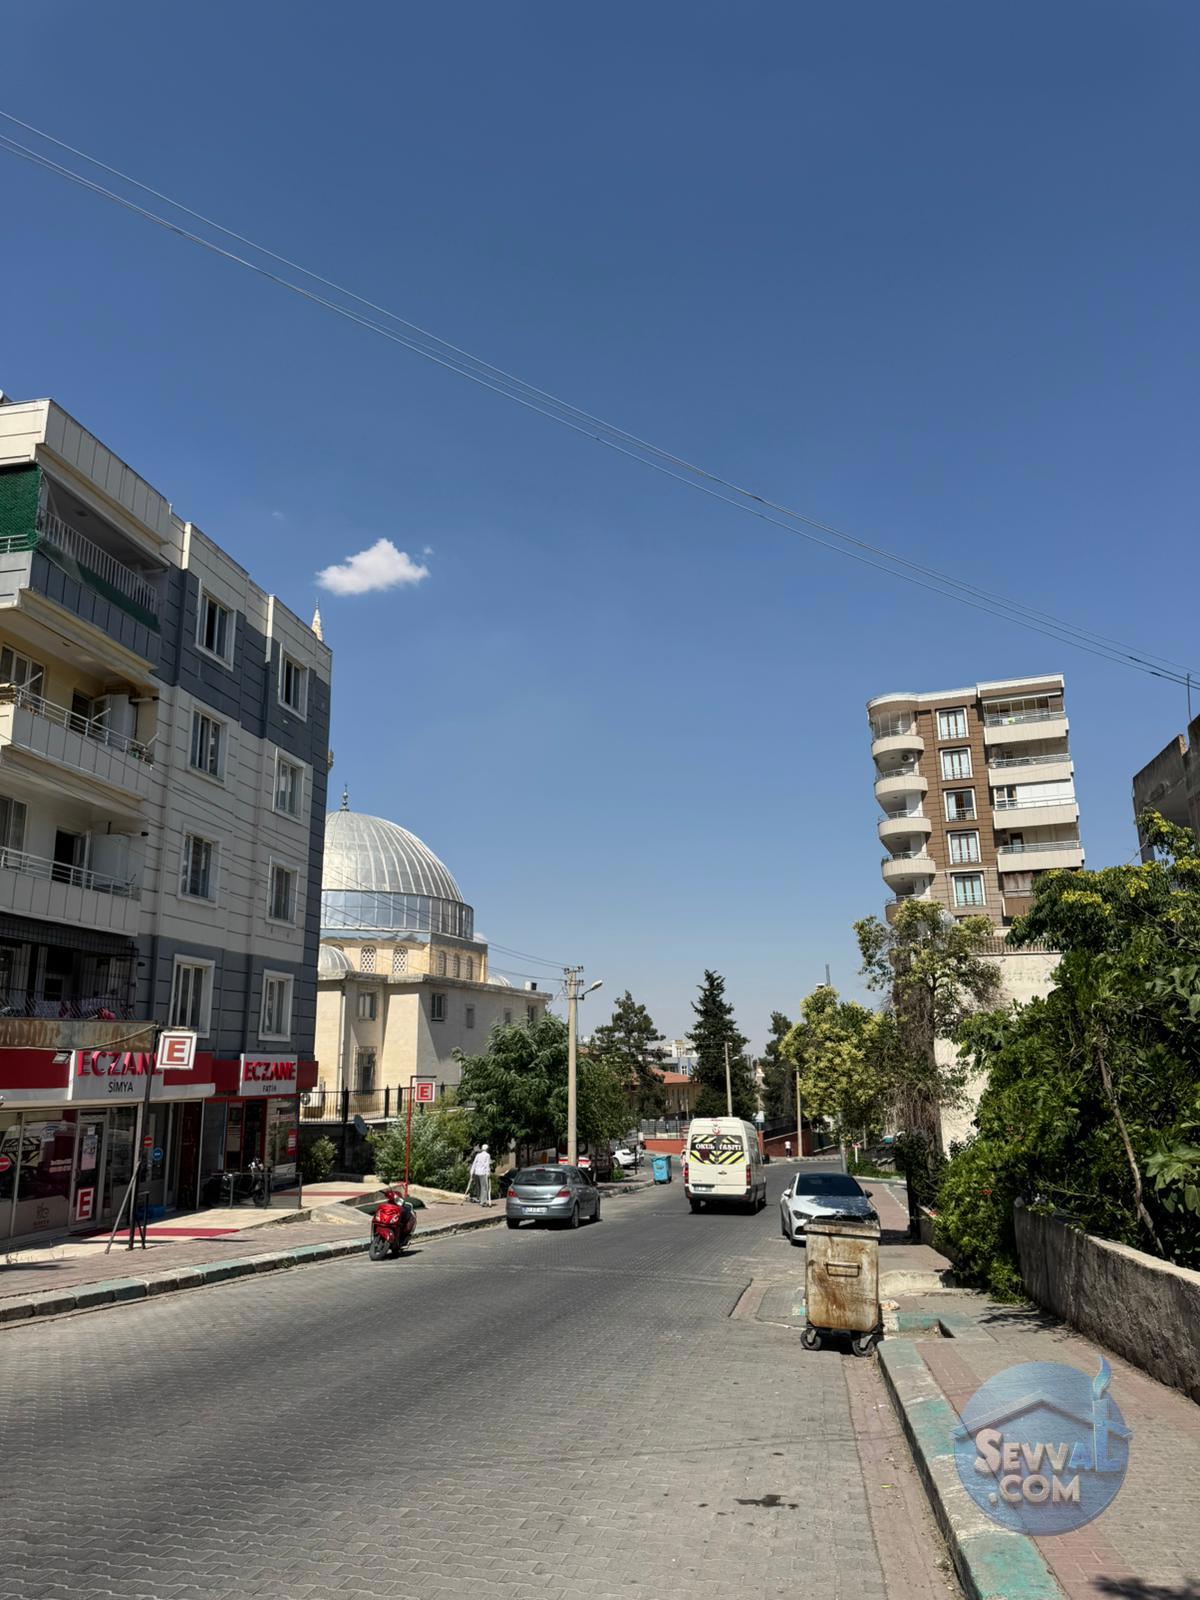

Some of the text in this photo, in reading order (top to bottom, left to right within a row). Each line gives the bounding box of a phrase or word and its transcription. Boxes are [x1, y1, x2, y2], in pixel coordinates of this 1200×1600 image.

[167, 1039, 186, 1062] E
[243, 1061, 296, 1081] ECZANE
[108, 1080, 134, 1093] SİMYA
[420, 1086, 430, 1098] E
[79, 1191, 92, 1217] E
